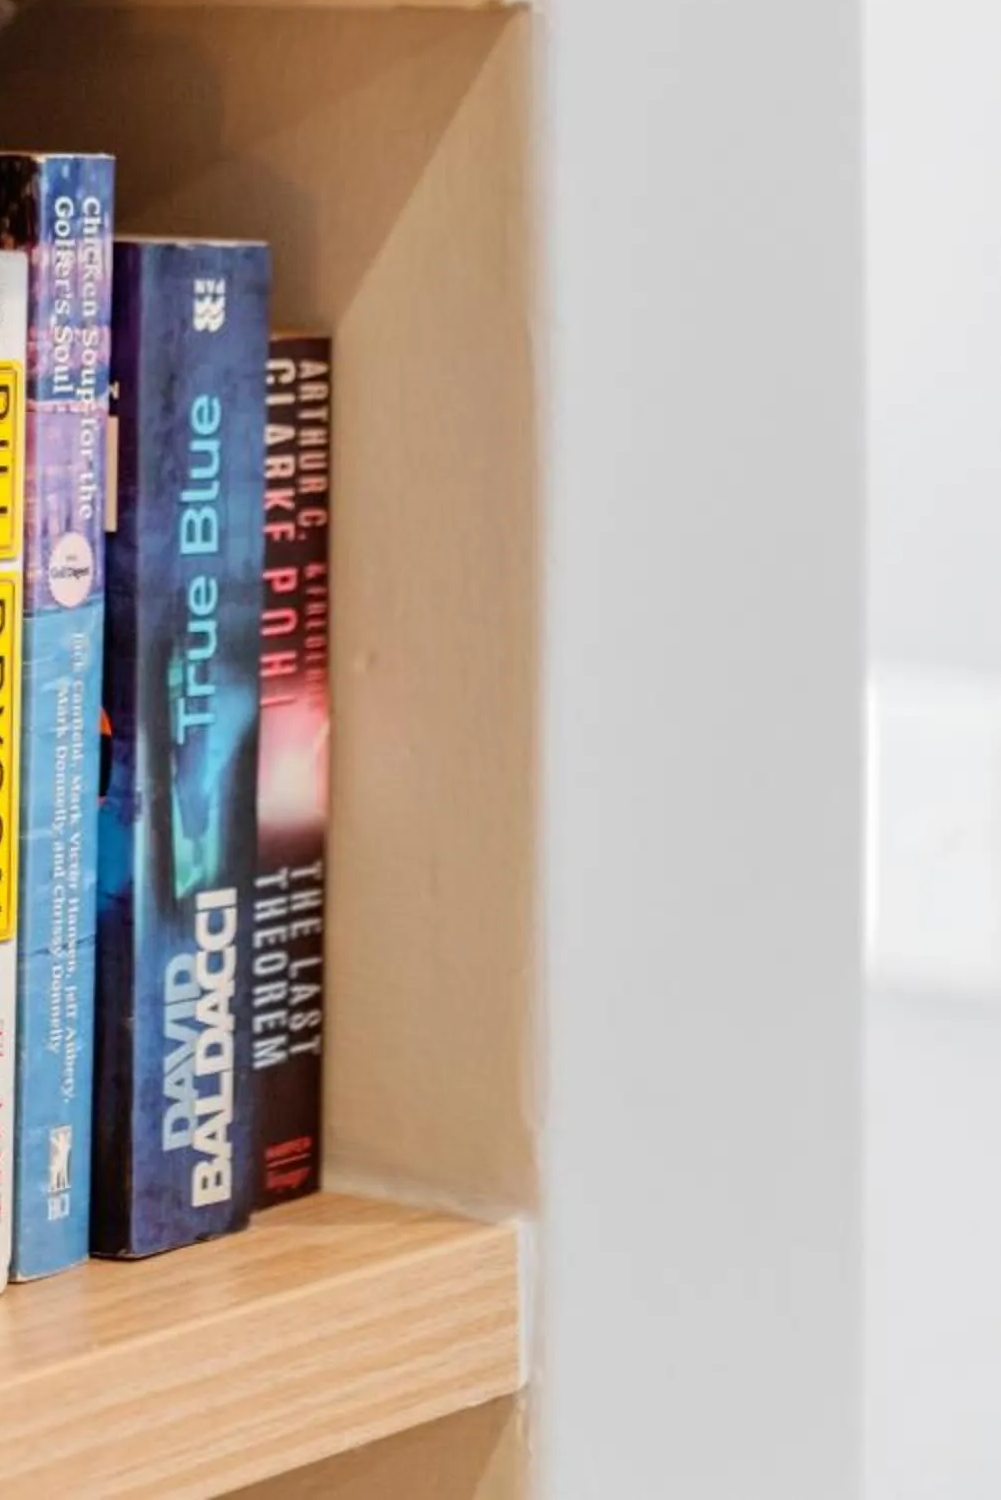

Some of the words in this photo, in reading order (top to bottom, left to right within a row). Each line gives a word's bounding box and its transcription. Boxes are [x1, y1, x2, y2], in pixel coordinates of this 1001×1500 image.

[53, 196, 75, 316] Golfer's
[80, 196, 101, 319] Chicken
[52, 324, 74, 395] Soul
[76, 328, 100, 406] Soup
[78, 417, 98, 464] for
[179, 393, 223, 556] Blue
[297, 358, 329, 495] ARTHUR
[78, 473, 95, 521] the
[175, 575, 218, 745] True
[289, 860, 323, 938] THE
[252, 866, 289, 1071] THEOREM
[288, 956, 322, 1056] LAST
[162, 951, 200, 1153] DAVID
[192, 886, 238, 1209] BALDACCI
